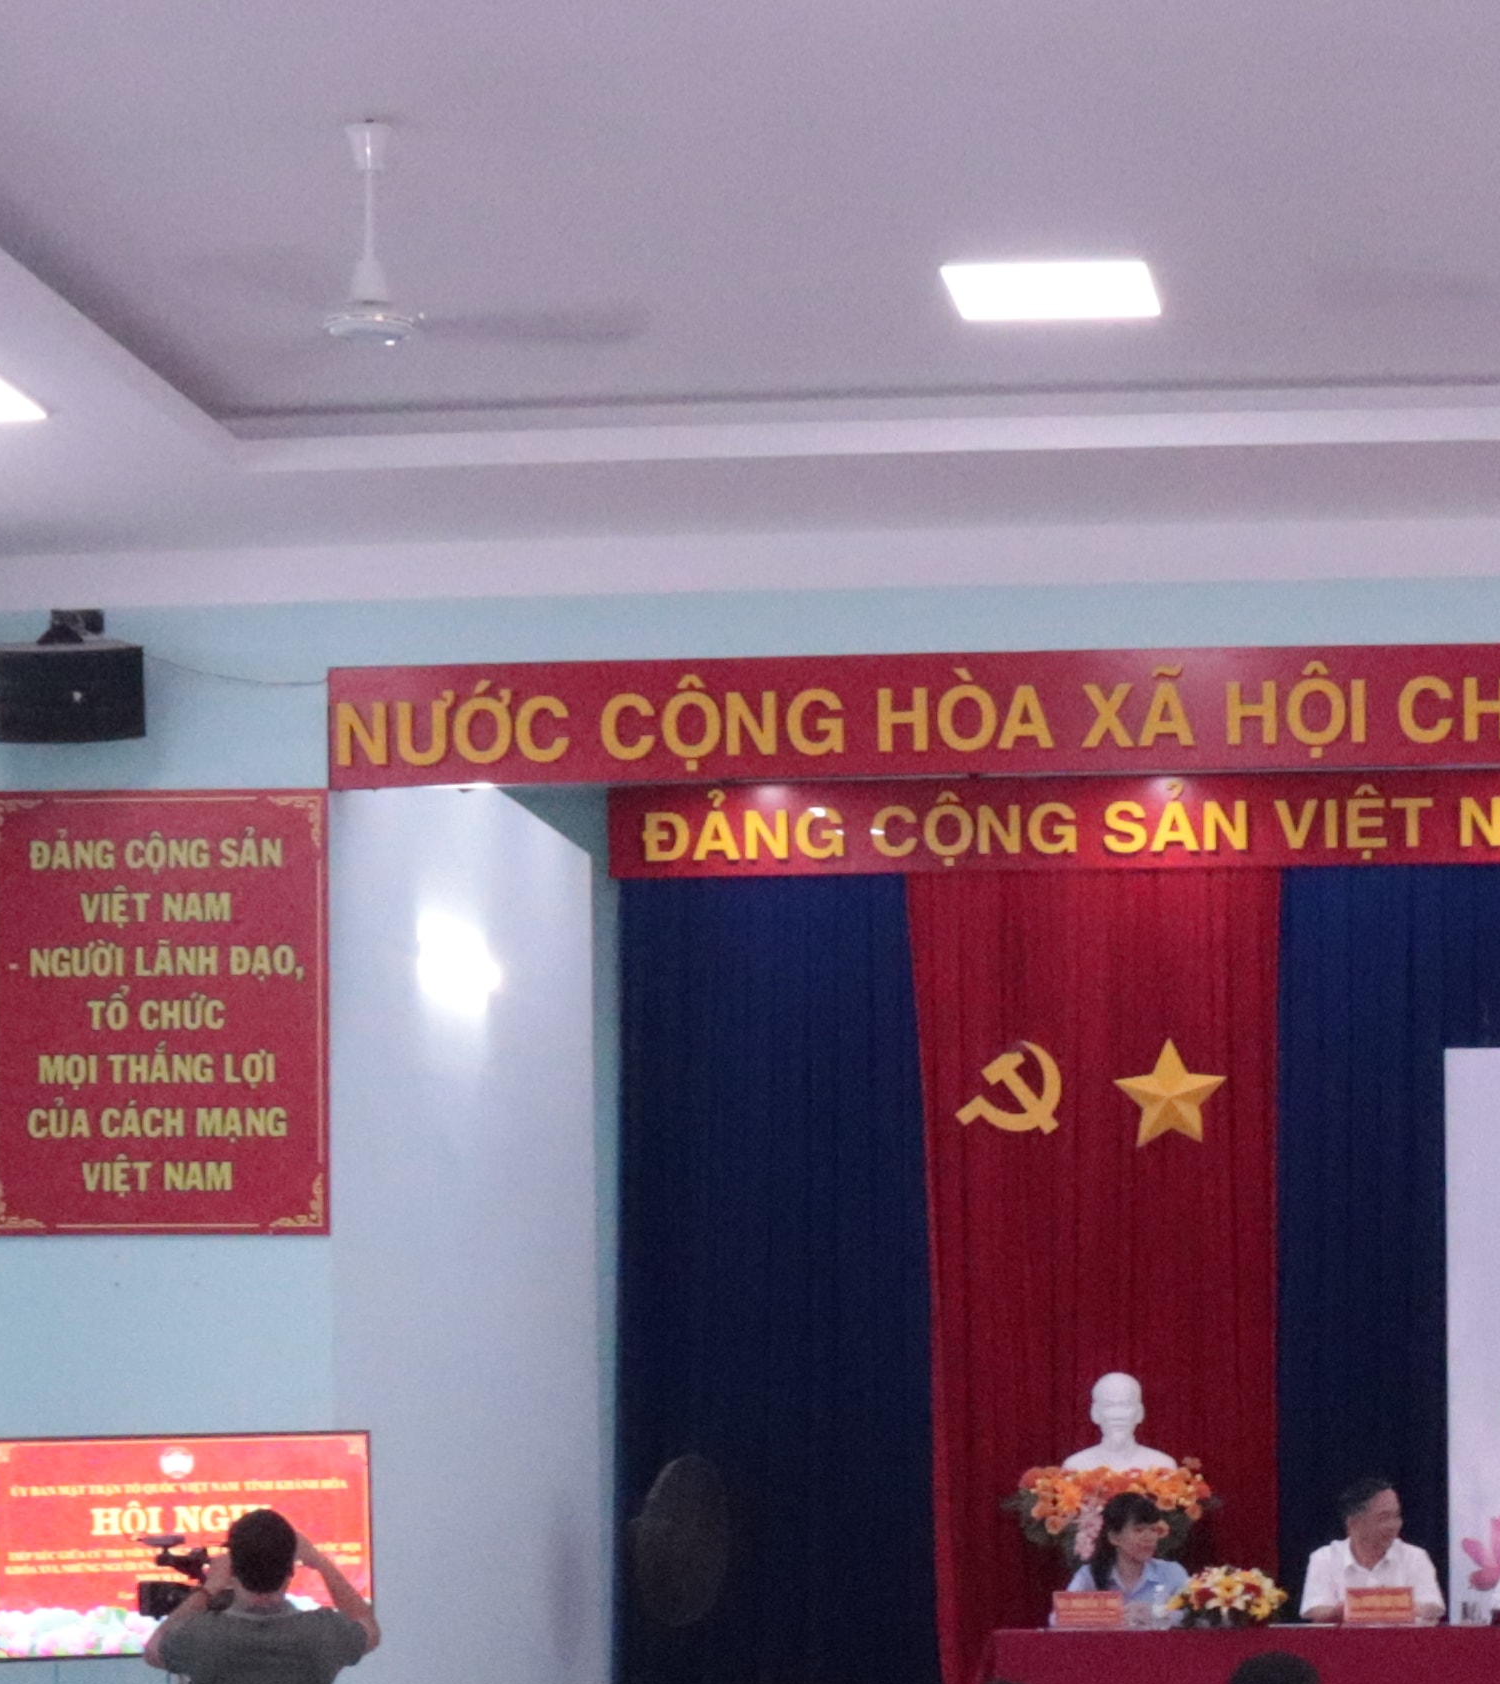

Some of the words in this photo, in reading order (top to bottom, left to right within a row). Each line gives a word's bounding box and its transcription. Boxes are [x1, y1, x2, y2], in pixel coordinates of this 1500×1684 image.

[335, 680, 568, 766] NƯỚC
[601, 674, 843, 771] CỘNG
[878, 668, 1054, 751] HÒA
[1083, 658, 1201, 746] XÃ
[1222, 654, 1365, 758] HỘI
[644, 786, 845, 860] ĐẢNG
[869, 793, 1077, 866] CỘNG
[1104, 778, 1246, 853] SẢN
[1274, 785, 1433, 860] VIỆT
[30, 830, 115, 869] ĐẢNG
[125, 831, 210, 873] CỘNG
[220, 827, 282, 868] SẢN
[81, 885, 151, 928] VIỆT
[163, 892, 230, 921] NAM
[31, 940, 124, 977] NGƯỜI
[135, 940, 219, 976] LÃNH
[230, 945, 303, 980] ĐẠO,
[87, 985, 129, 1030] TỔ
[139, 993, 225, 1030] CHỨC
[39, 1054, 97, 1090] MỌI
[108, 1042, 214, 1083] THẮNG
[224, 1049, 275, 1088] LỢI
[28, 1098, 90, 1138] CỦA
[101, 1101, 184, 1138] CÁCH
[197, 1107, 287, 1142] MẠNG
[83, 1154, 152, 1197] VIỆT
[164, 1162, 232, 1190] NAM
[90, 1500, 163, 1541] HỘI
[173, 1504, 272, 1534] NG
